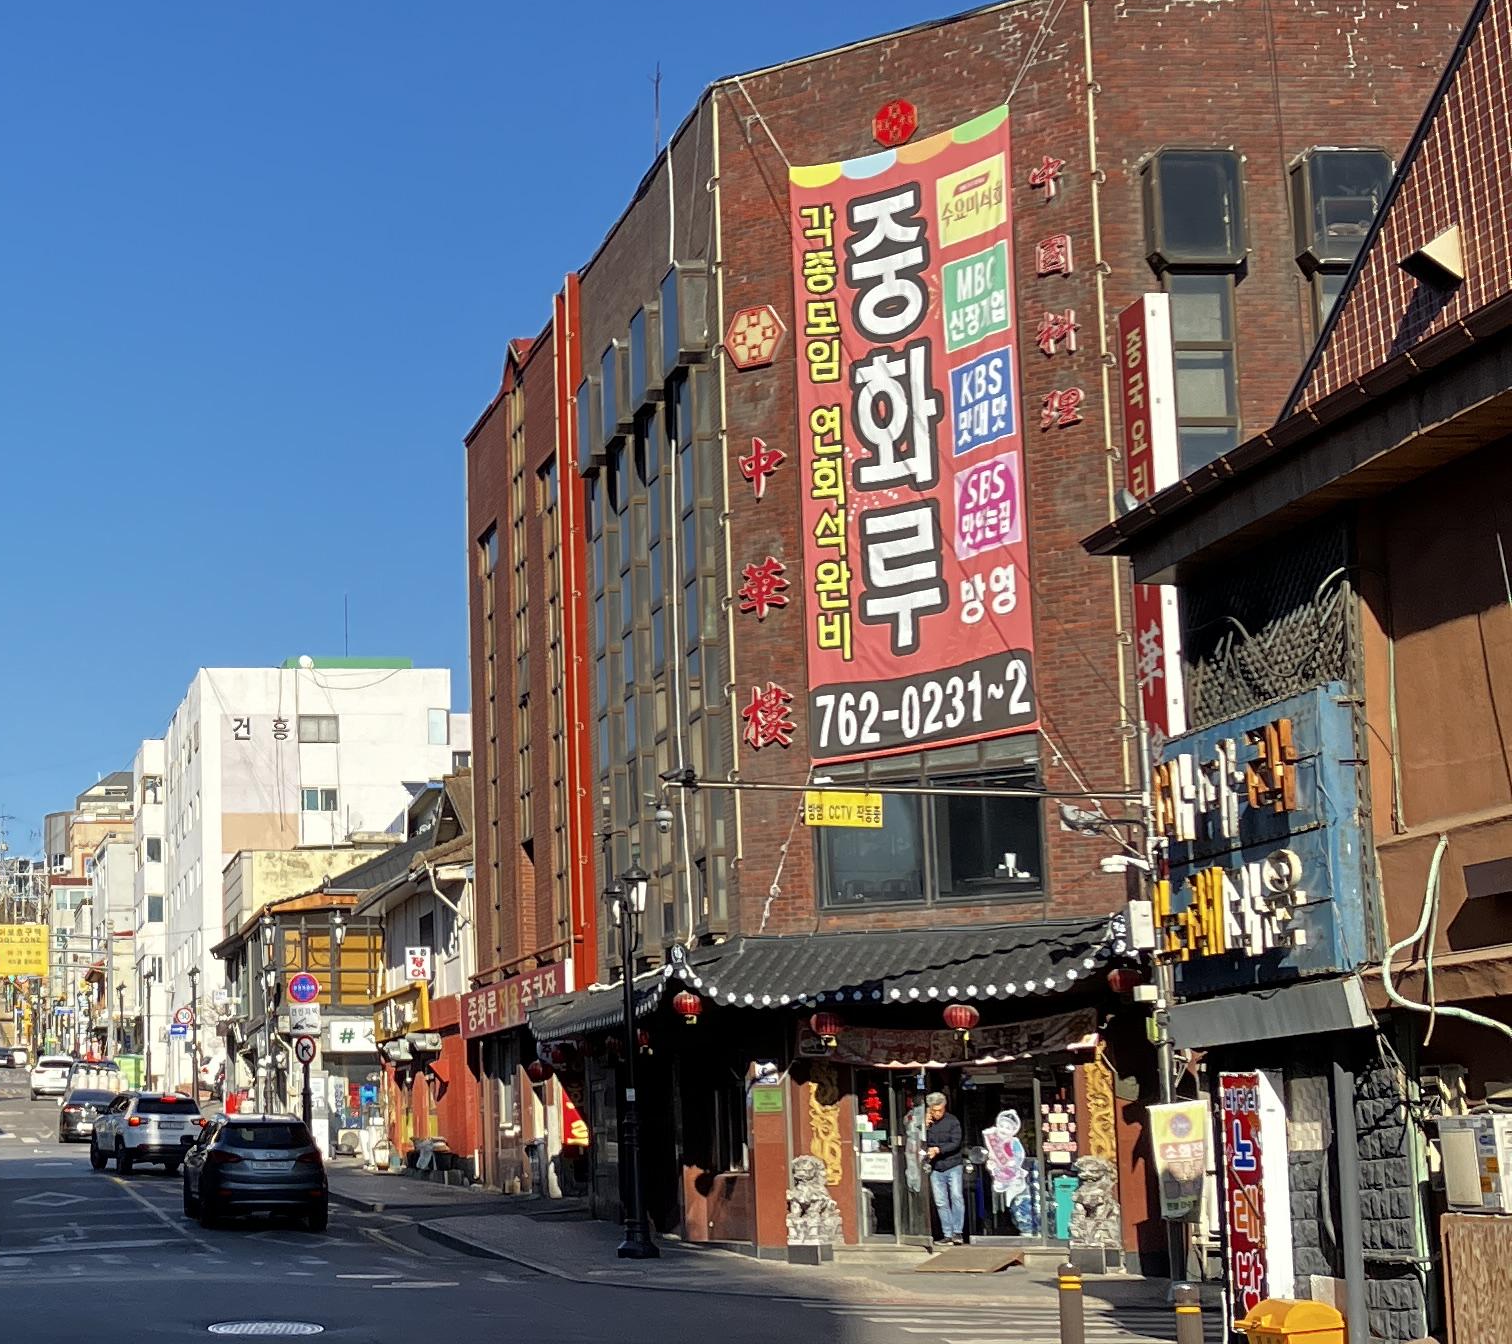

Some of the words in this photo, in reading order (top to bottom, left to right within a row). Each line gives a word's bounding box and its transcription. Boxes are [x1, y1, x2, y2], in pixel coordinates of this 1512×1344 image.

[799, 205, 843, 385] 각종모임
[956, 257, 996, 303] MBC
[960, 358, 1004, 407] KBS
[846, 184, 949, 654] 중화루
[965, 463, 1006, 510] SBS
[808, 402, 854, 660] 연회석완비
[960, 563, 1017, 624] 방영
[815, 659, 1031, 749] 762-0231~2
[829, 805, 852, 820] CCTV
[467, 990, 498, 1033] 중화루
[1231, 1119, 1264, 1293] 노래바
